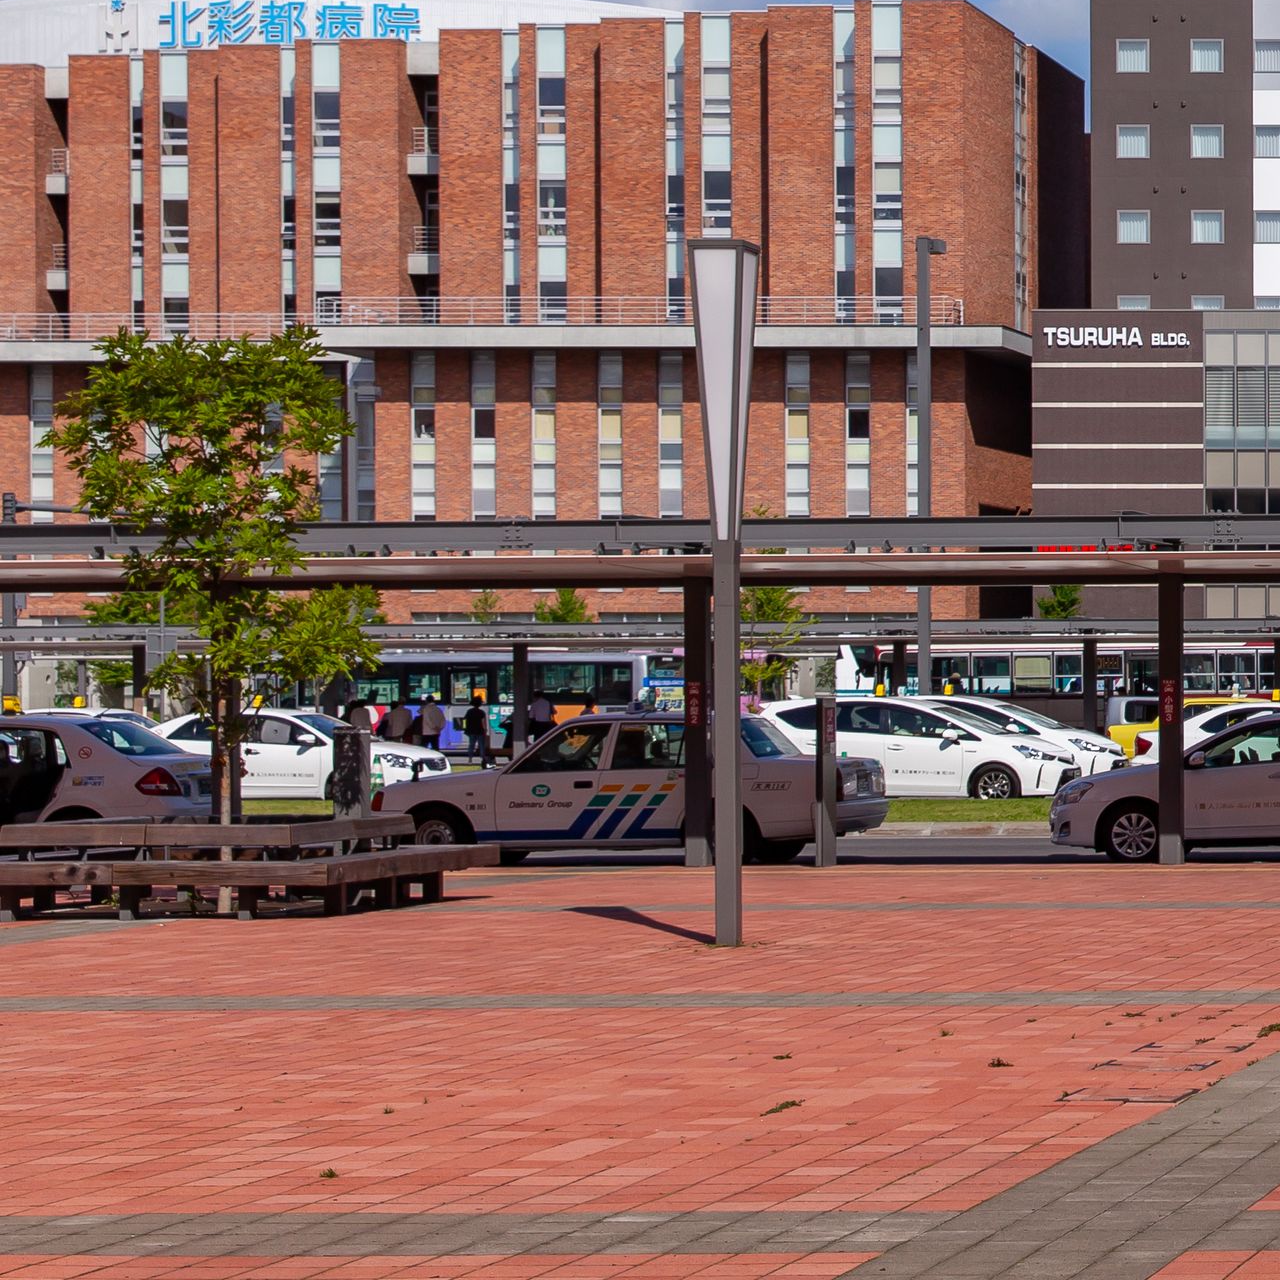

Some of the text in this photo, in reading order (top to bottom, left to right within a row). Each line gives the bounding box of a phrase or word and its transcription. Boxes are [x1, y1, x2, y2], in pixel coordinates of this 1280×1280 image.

[159, 0, 420, 48] 北彩都病院
[1043, 327, 1190, 346] TSURUHA BLDG.
[508, 800, 573, 809] Daimaru Group
